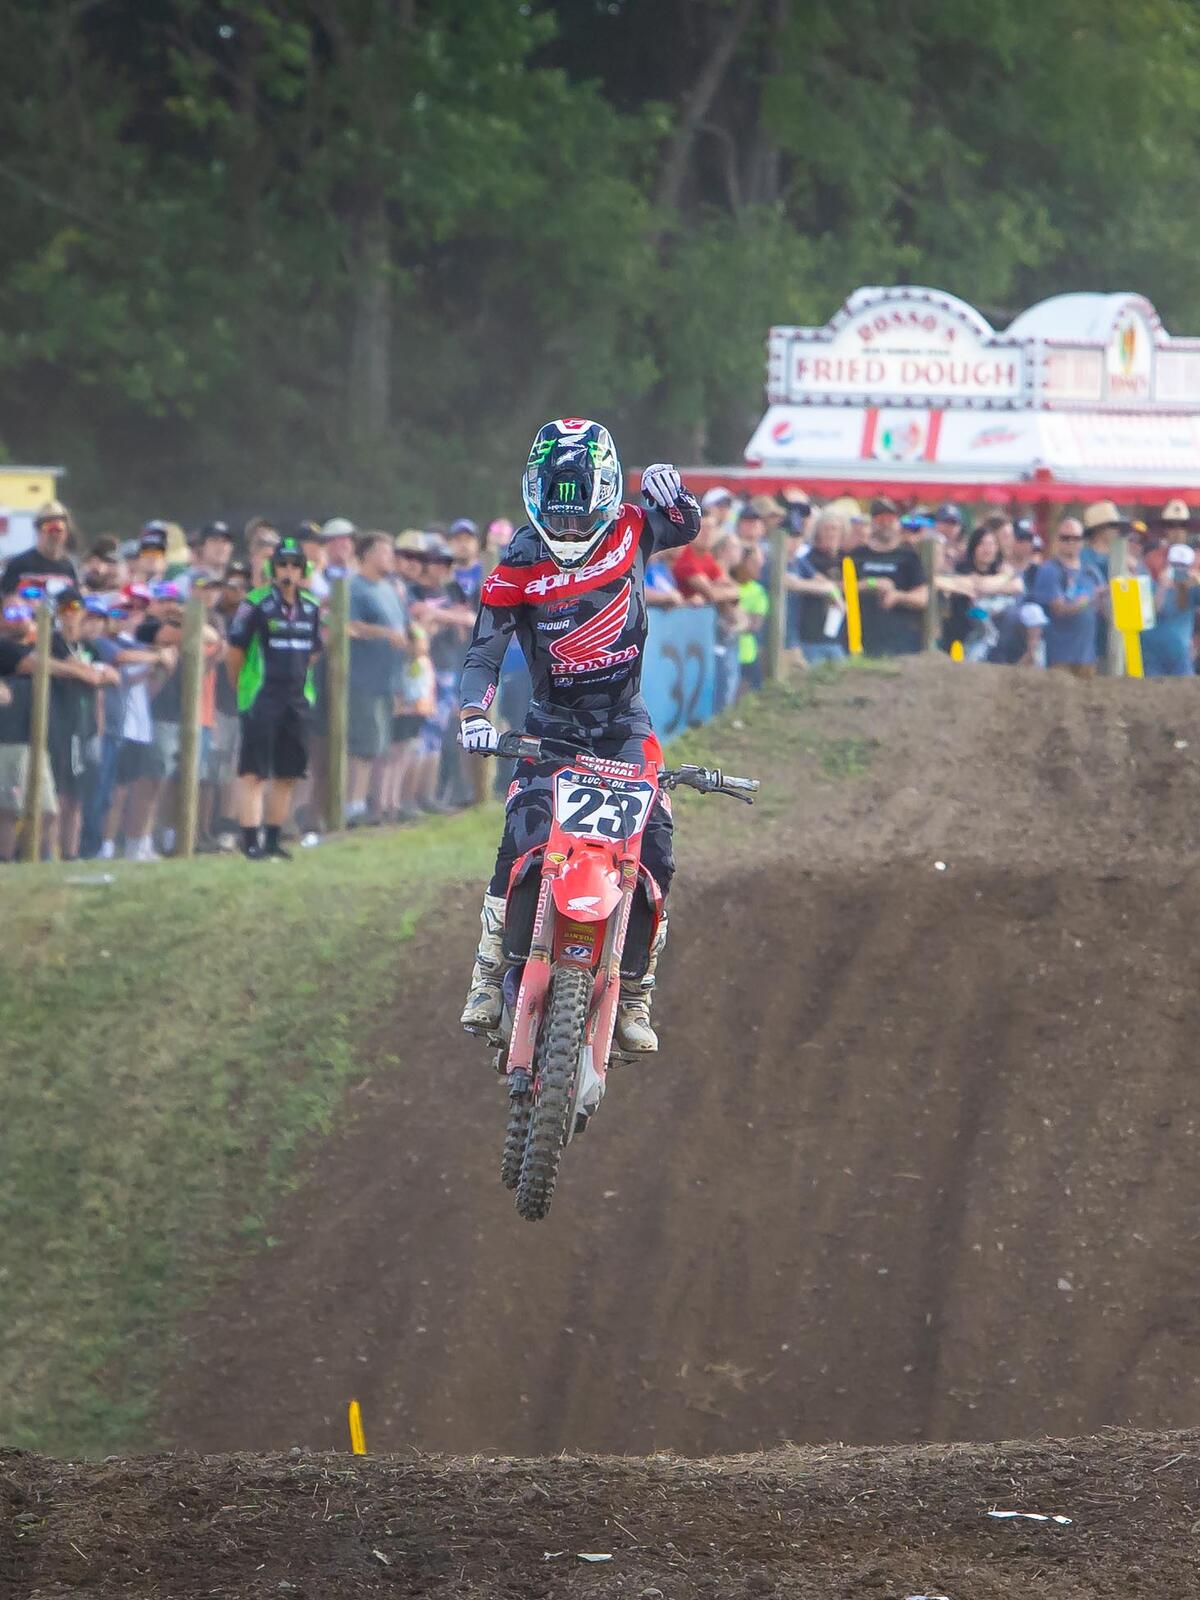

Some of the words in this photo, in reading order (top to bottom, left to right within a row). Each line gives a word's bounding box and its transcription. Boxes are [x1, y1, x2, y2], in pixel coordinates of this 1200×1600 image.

[796, 358, 885, 383] FRIED
[901, 360, 1016, 386] DOUGH
[537, 619, 570, 631] SHOWA
[552, 645, 639, 675] HONDA
[582, 775, 612, 788] LUC
[612, 780, 626, 789] OIL
[560, 788, 642, 839] 23
